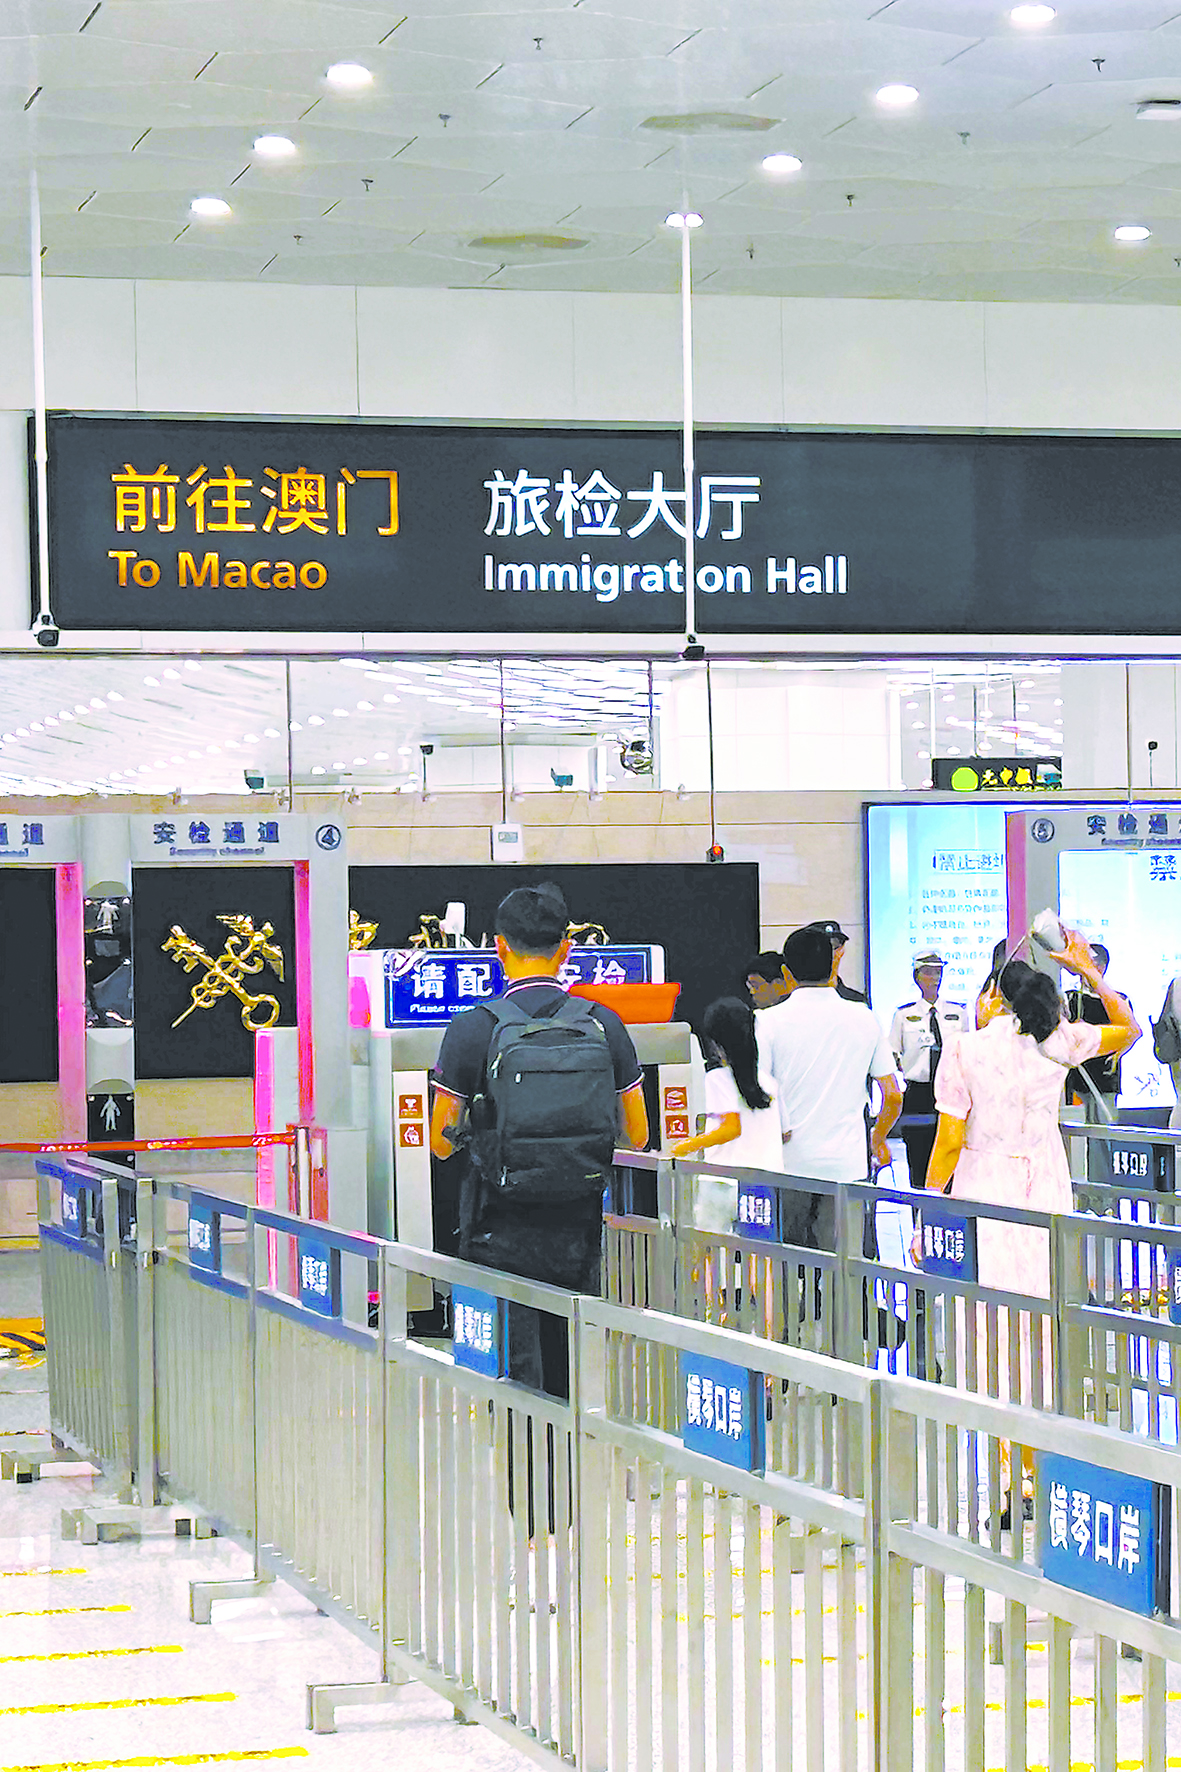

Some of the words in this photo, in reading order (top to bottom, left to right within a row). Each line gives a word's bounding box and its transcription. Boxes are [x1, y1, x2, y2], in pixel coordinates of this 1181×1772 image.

[109, 463, 401, 537] 前往澳门
[484, 469, 762, 541] 旅检大厅
[109, 551, 162, 590] To
[179, 552, 329, 591] Macao
[484, 553, 752, 602] Immigraton
[767, 555, 849, 594] Hall
[687, 1373, 743, 1441] 横琴口岸
[1049, 1480, 1141, 1576] 横琴口岸
